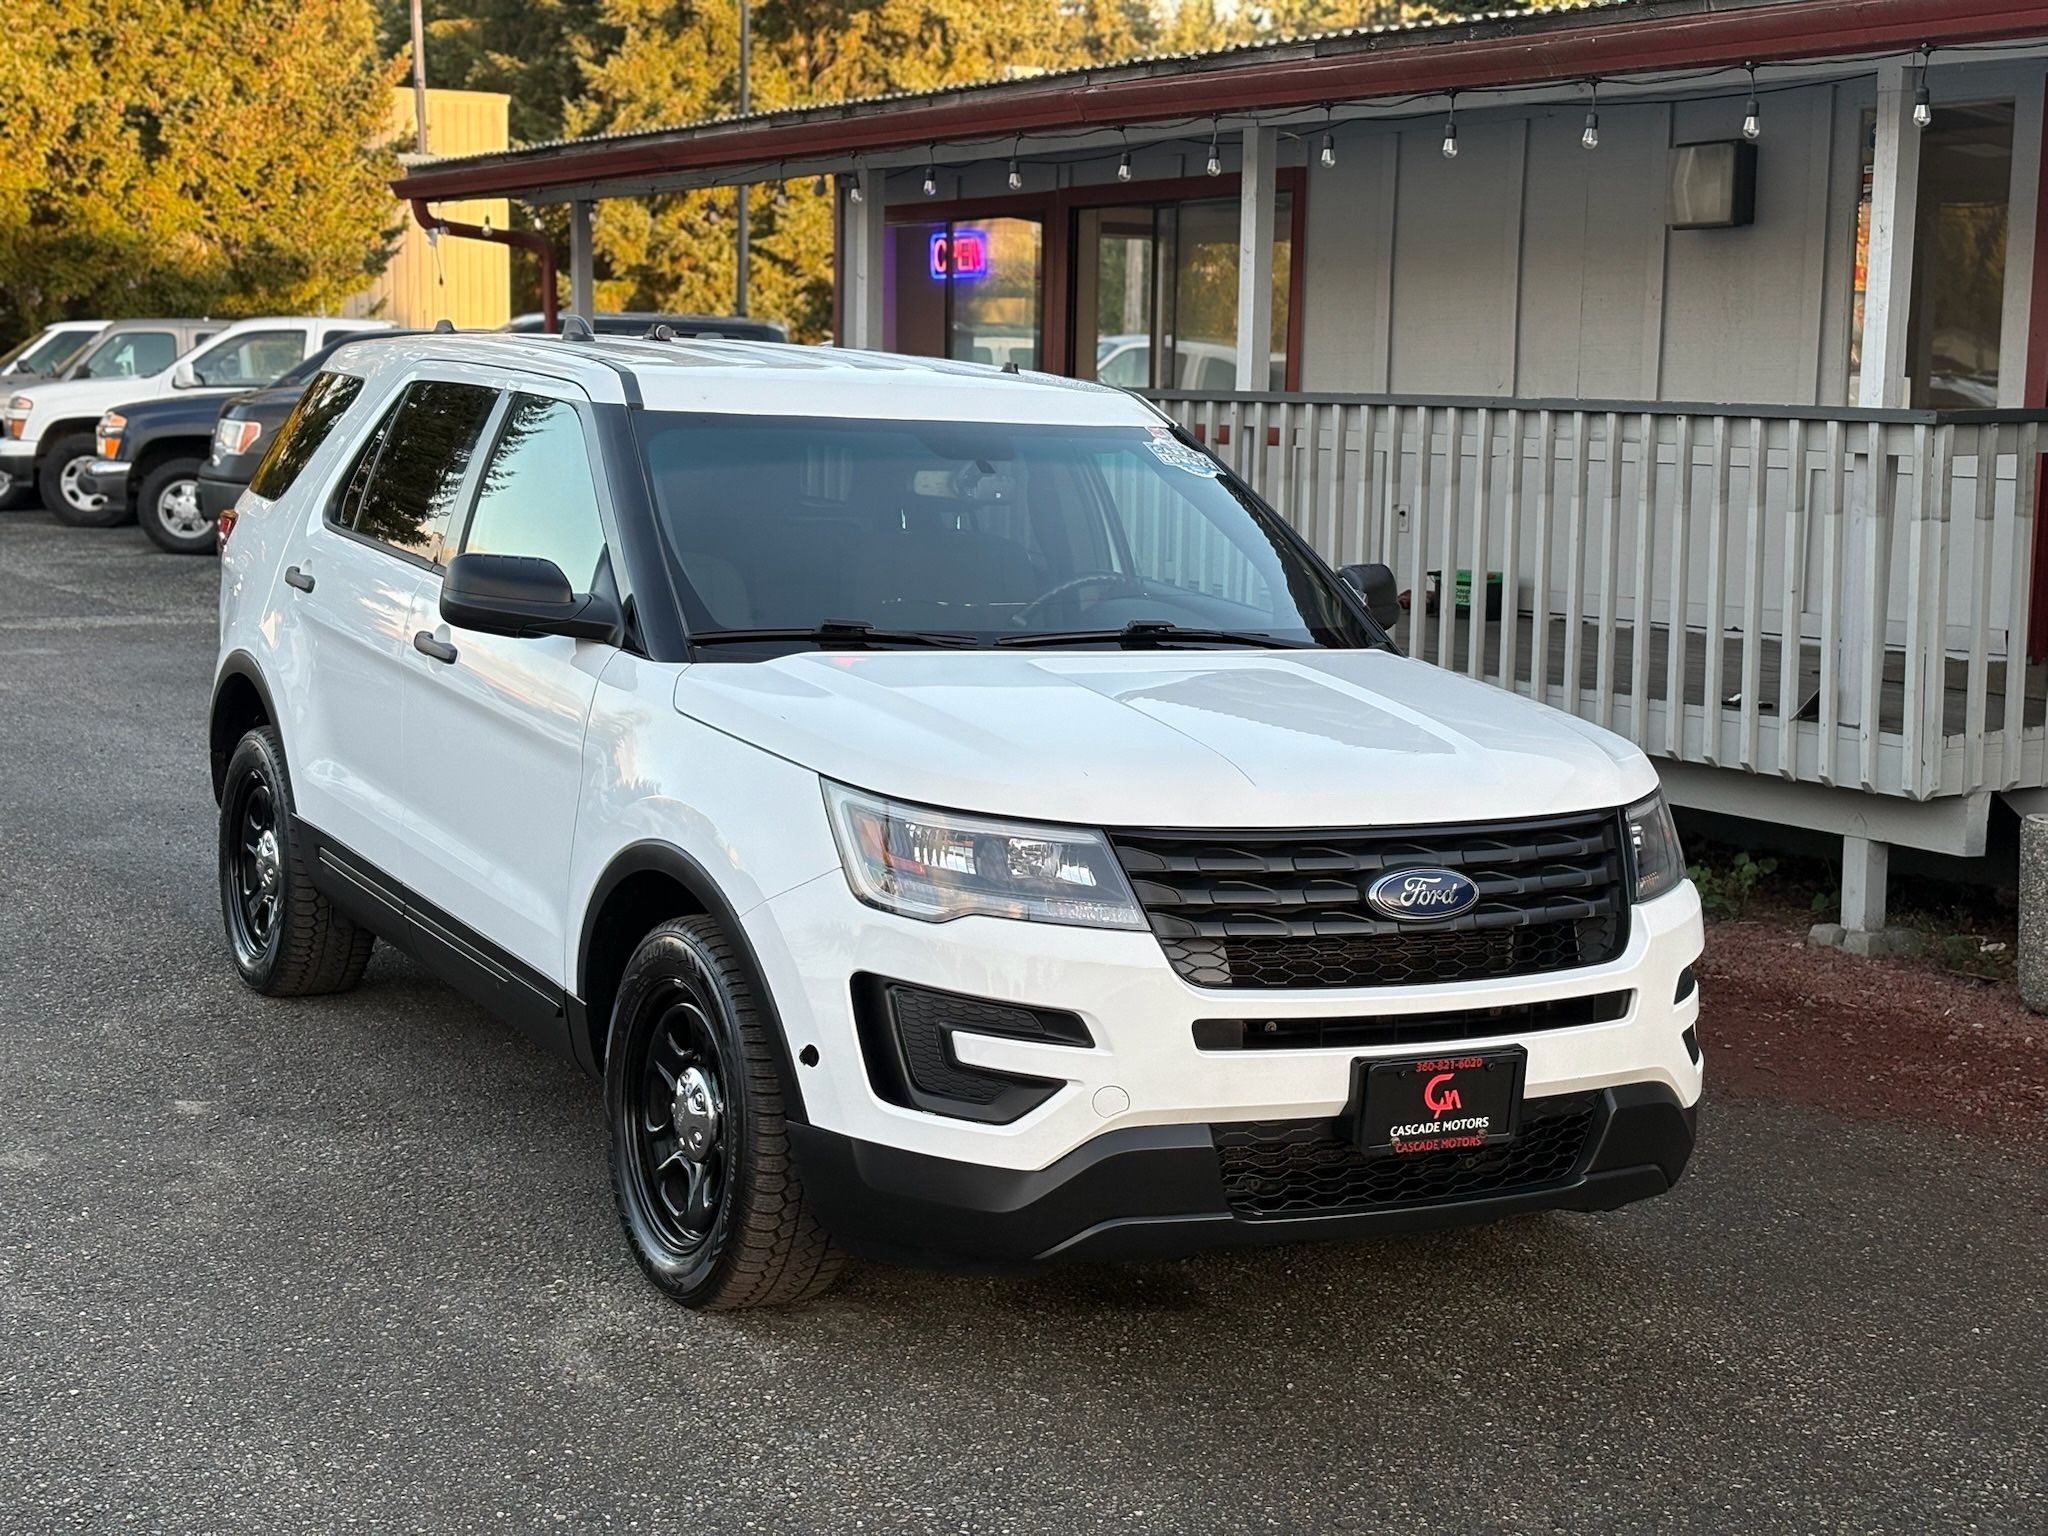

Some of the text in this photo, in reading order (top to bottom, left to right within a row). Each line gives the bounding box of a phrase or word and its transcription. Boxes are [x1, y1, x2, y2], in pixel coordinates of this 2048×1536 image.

[1400, 877, 1458, 907] Ford
[1416, 1057, 1483, 1072] 360-821-6020
[1390, 1116, 1490, 1137] CASCADE MOTORS
[1395, 1136, 1482, 1153] CASCADE MOTORS
